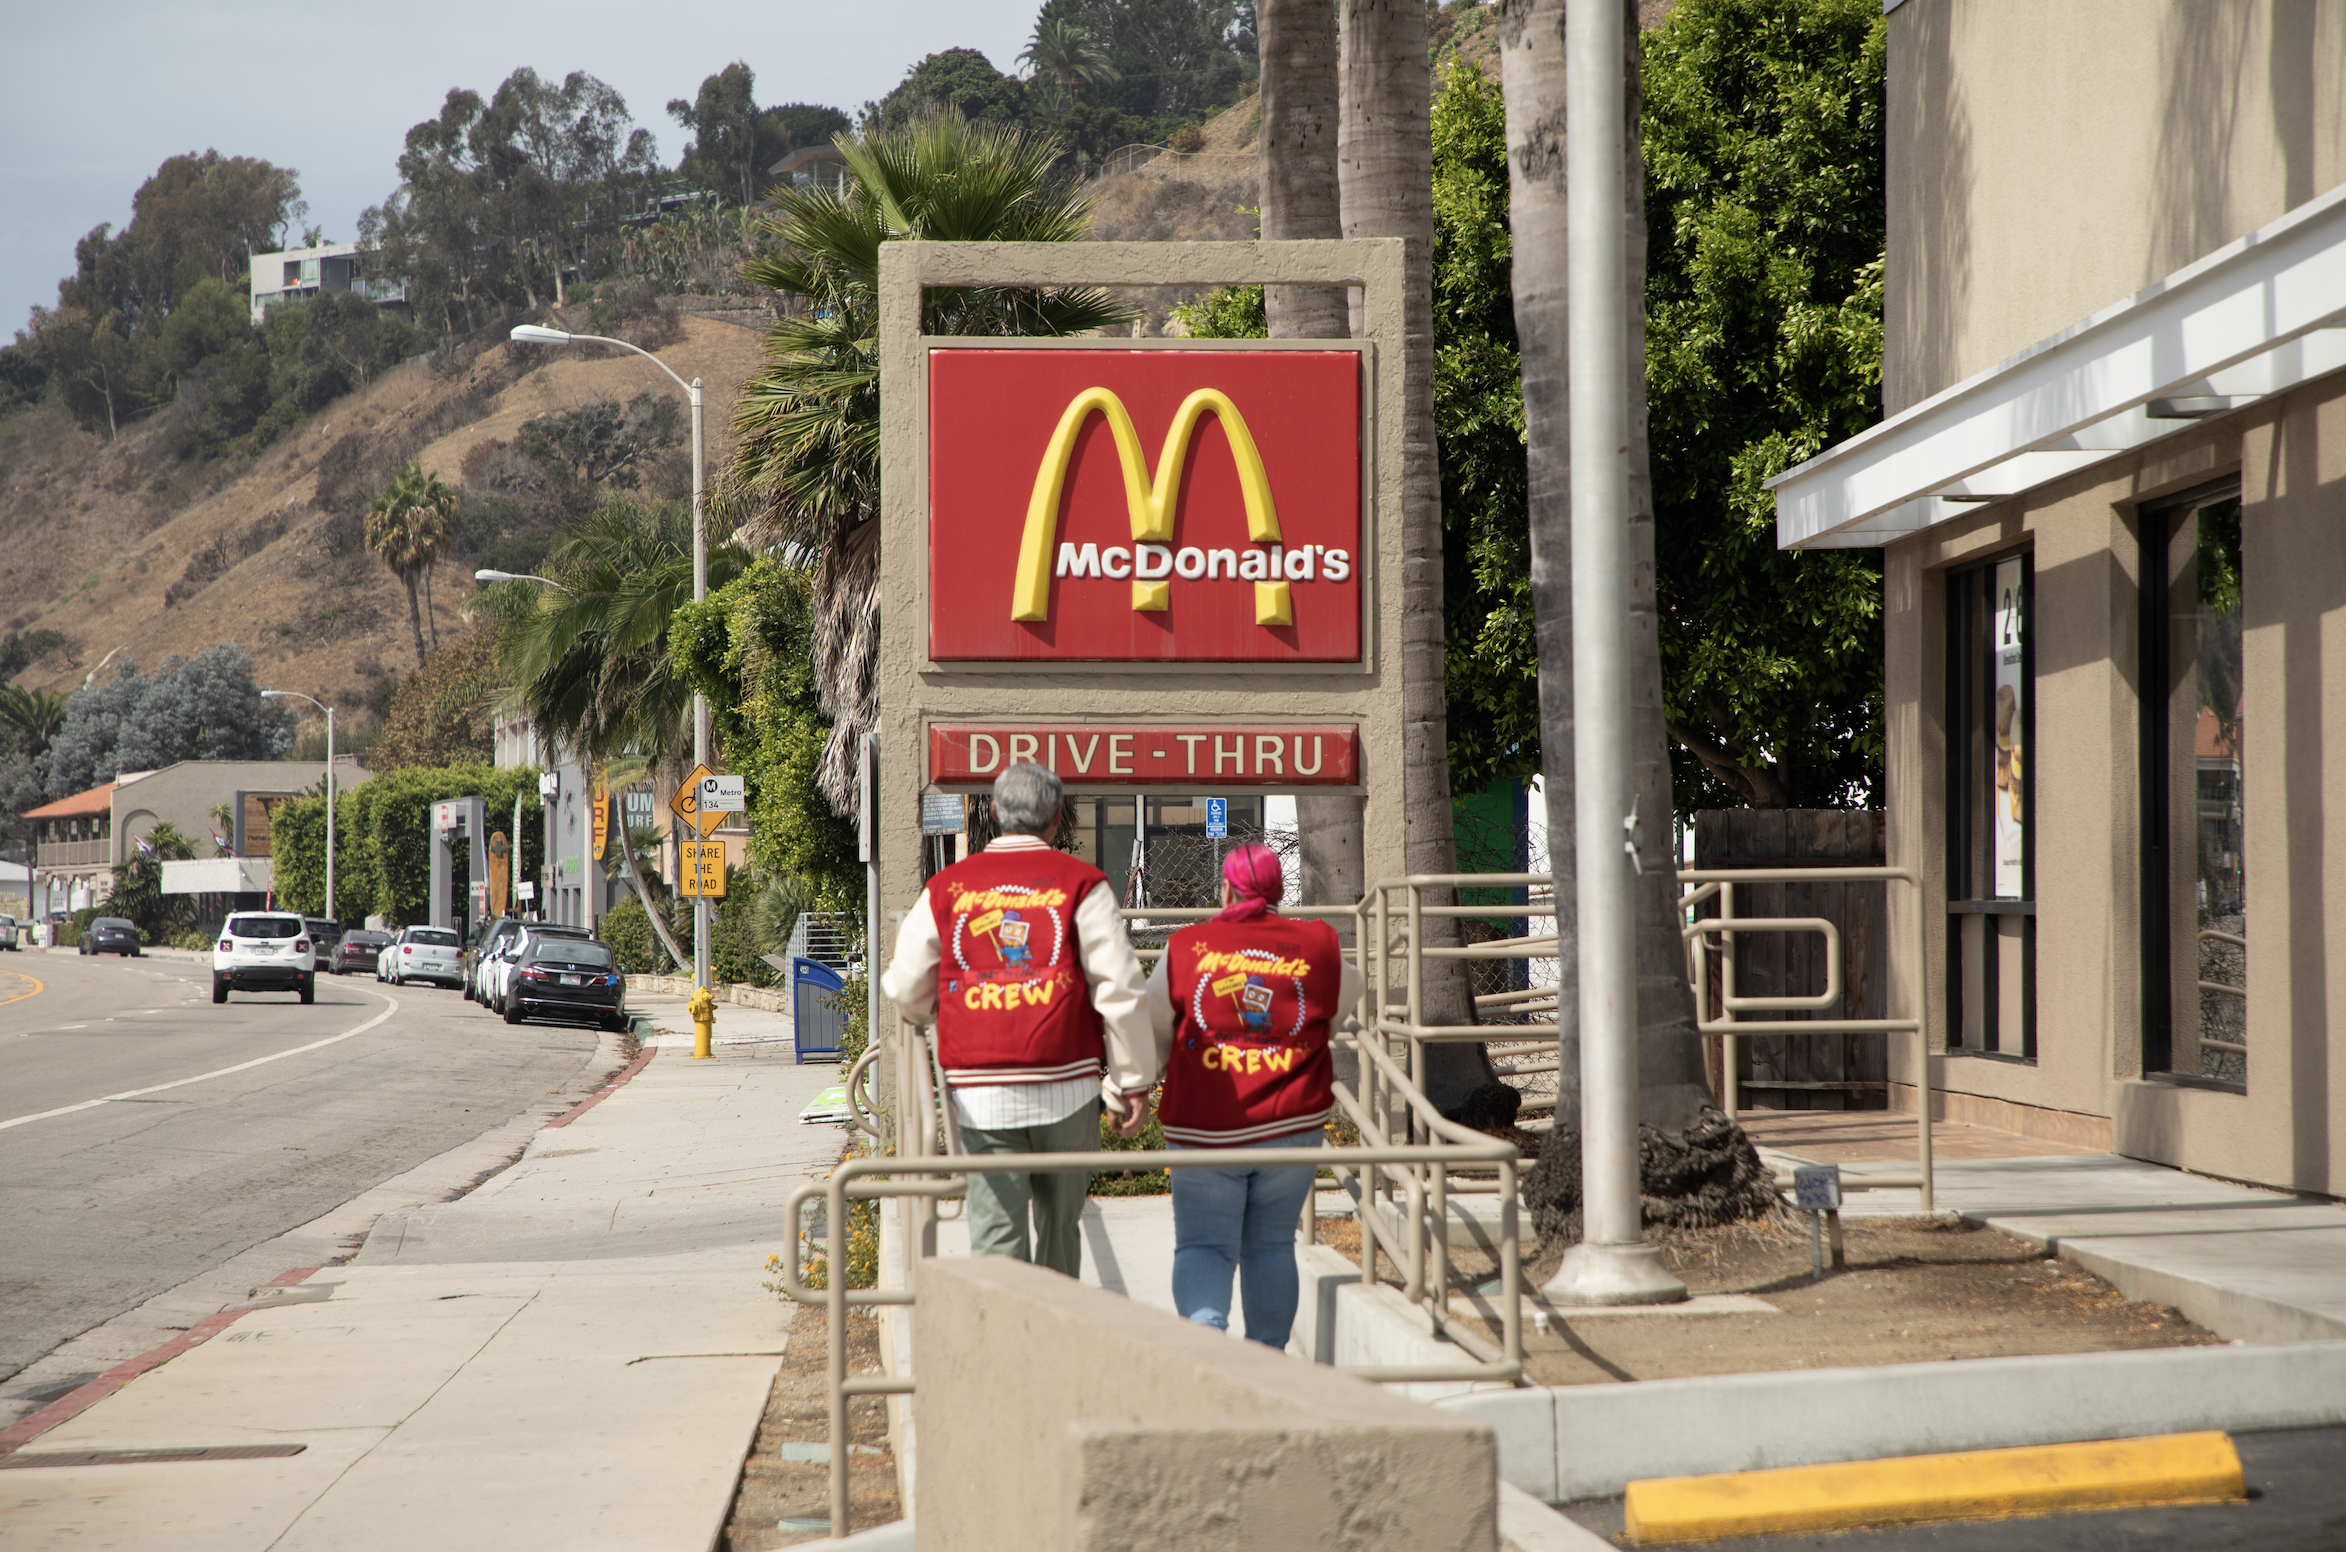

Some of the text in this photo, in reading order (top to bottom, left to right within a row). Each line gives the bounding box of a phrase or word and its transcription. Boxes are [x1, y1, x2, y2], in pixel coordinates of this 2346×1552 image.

[1056, 542, 1350, 581] McDonald's
[686, 848, 720, 858] SHARE
[690, 879, 717, 889] RAD
[953, 889, 1067, 913] McDonald's
[1196, 952, 1312, 977] McDonald's
[965, 979, 1054, 1011] CREW
[1203, 1046, 1292, 1075] CREW
